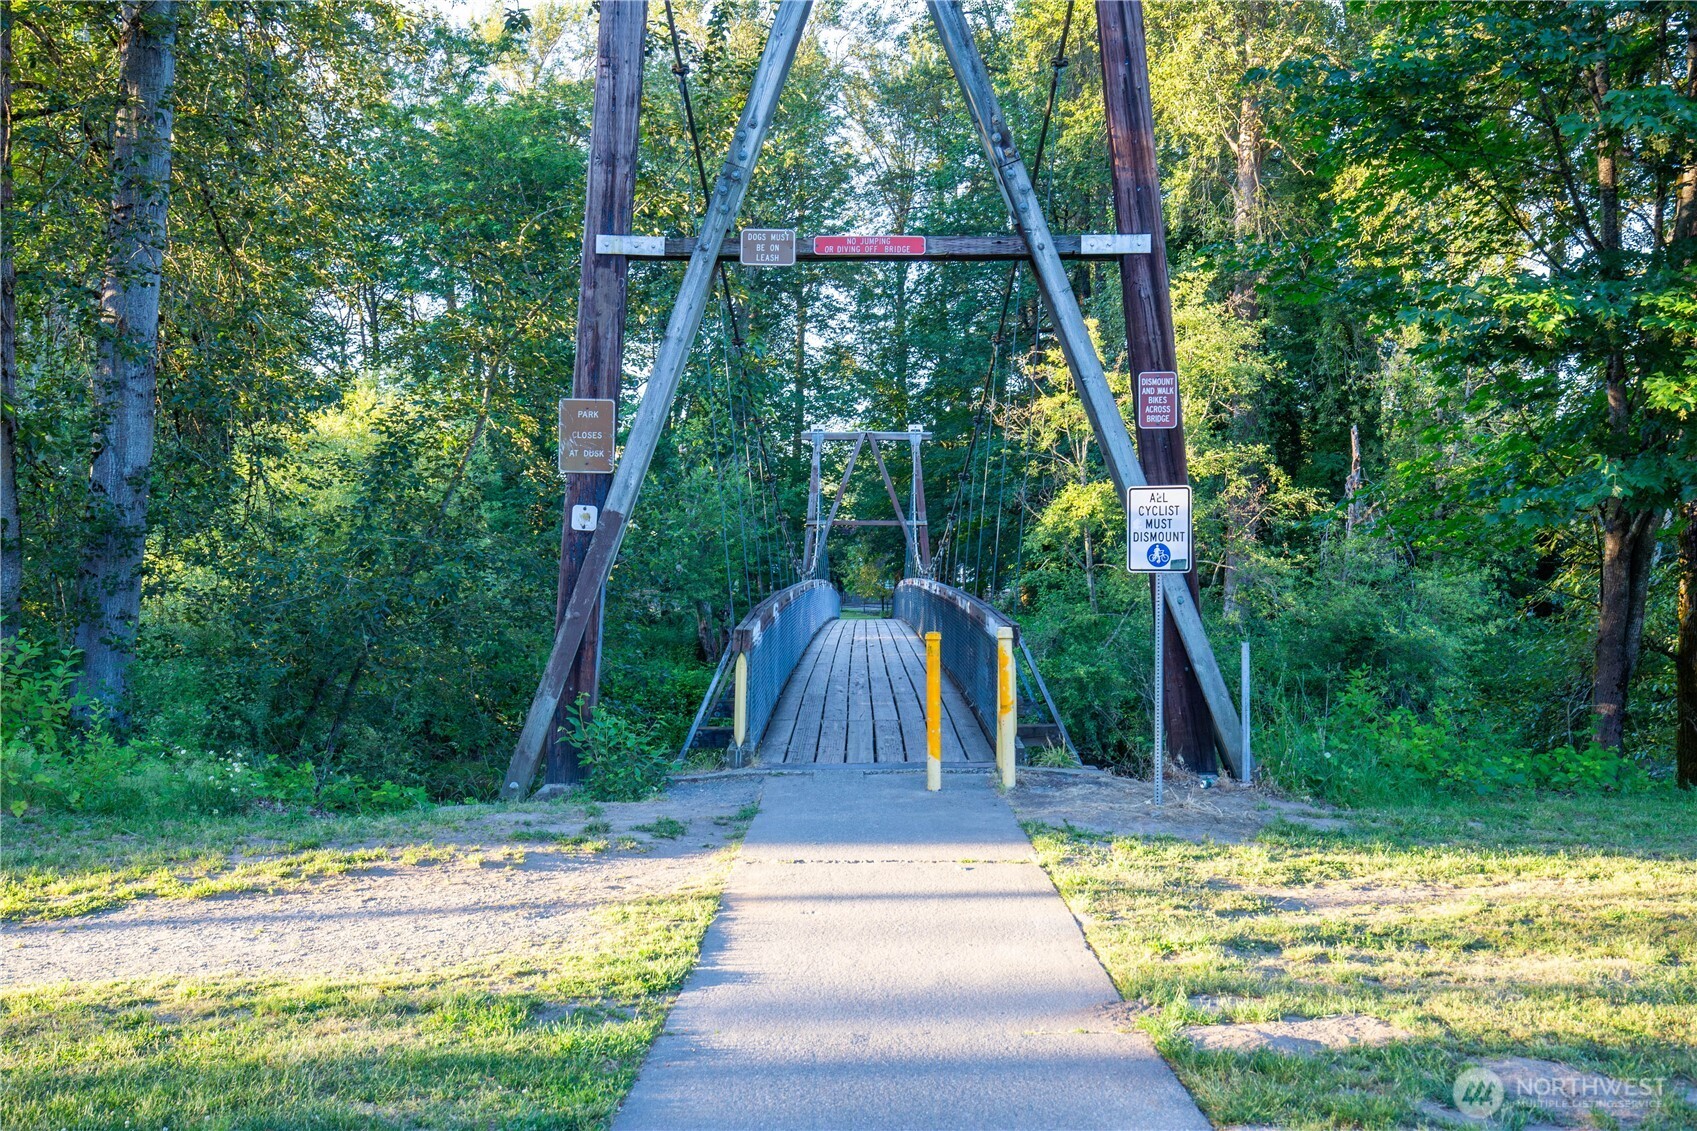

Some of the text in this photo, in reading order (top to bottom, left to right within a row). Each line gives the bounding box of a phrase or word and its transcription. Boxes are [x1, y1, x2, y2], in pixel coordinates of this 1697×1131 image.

[1138, 505, 1180, 516] CYCLIST
[1146, 519, 1172, 529] MUST
[1133, 532, 1185, 542] DISMOUNT
